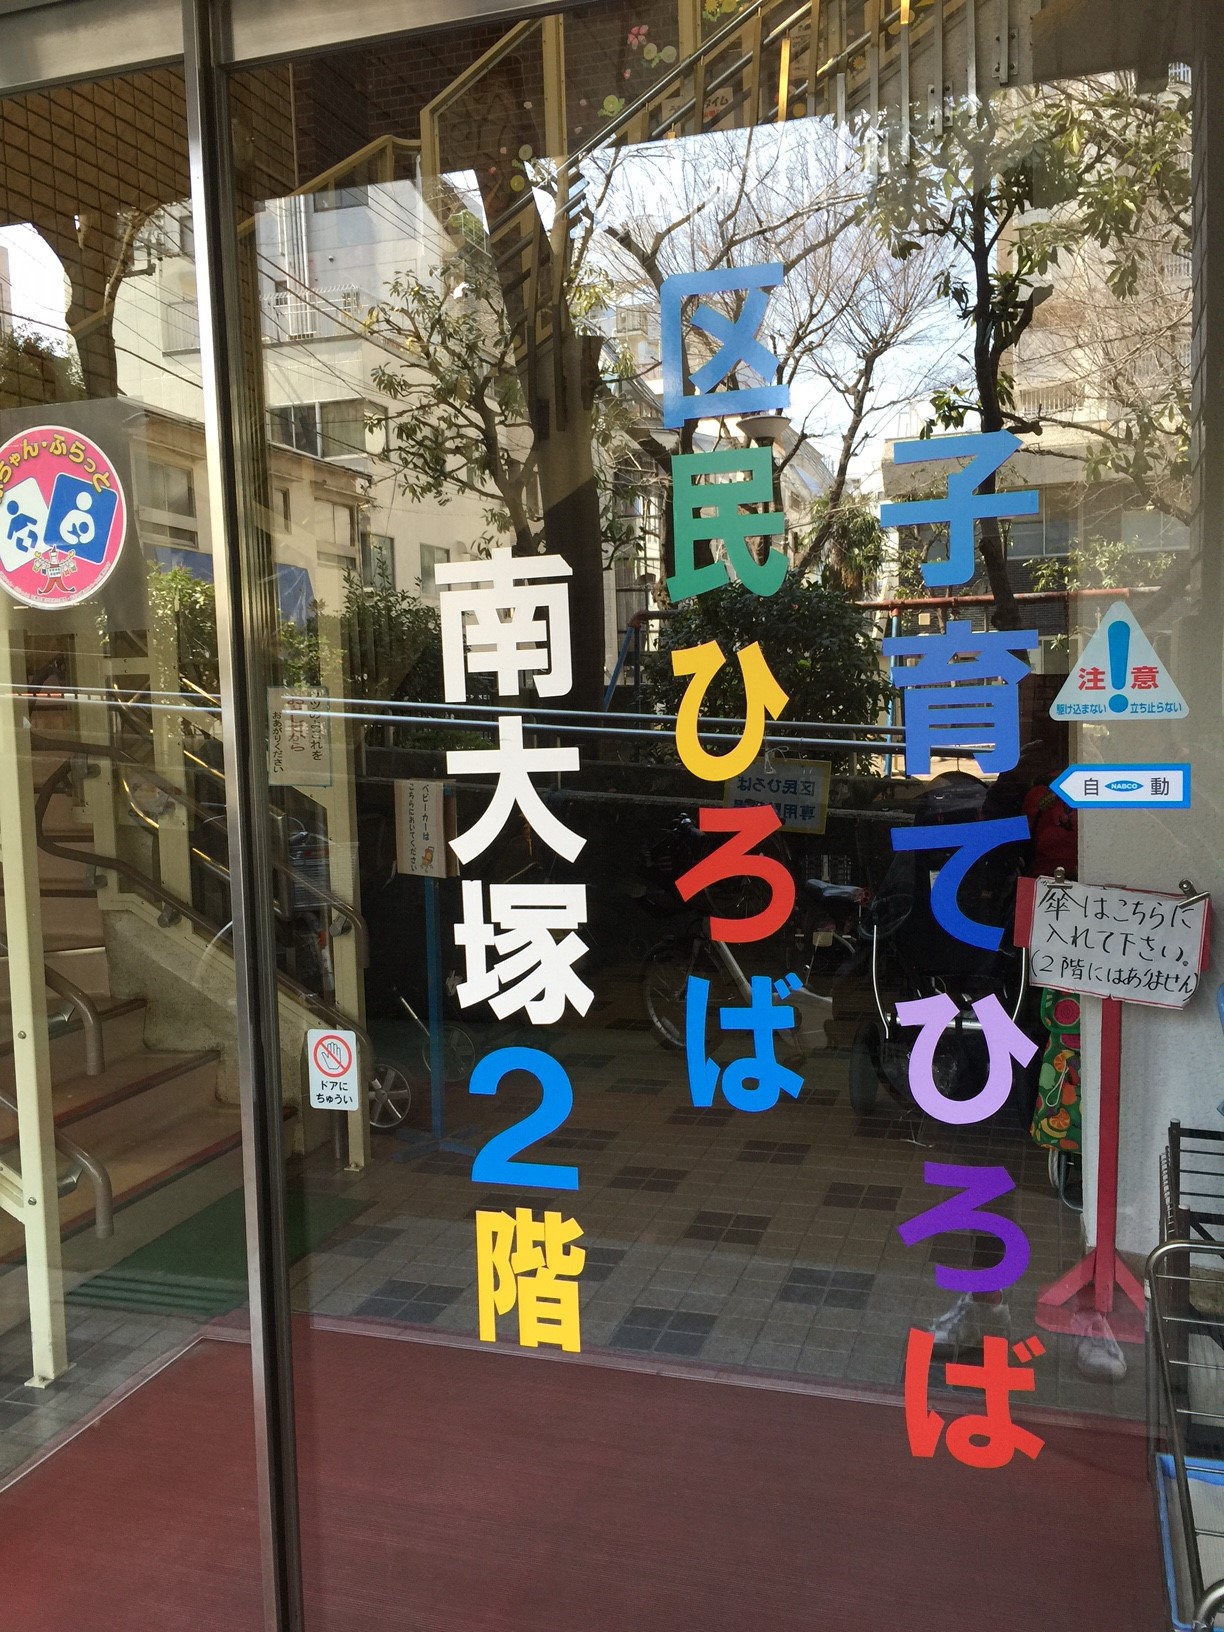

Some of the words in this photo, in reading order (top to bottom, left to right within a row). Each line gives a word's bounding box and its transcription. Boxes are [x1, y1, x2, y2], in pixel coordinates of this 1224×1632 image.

[660, 263, 804, 1112] 区民ひろば
[1056, 703, 1107, 715] 駆け込まない
[1130, 702, 1182, 714] 立ち止らない
[272, 711, 284, 773] おあがりください
[408, 783, 417, 872] こちらにおいてください
[422, 784, 430, 841] ベビーカーは
[1038, 887, 1195, 930] 傘はこちらに
[435, 548, 594, 1353] 南大塚2階
[881, 431, 1043, 1468] 子育てひろば
[316, 1093, 353, 1105] ちゅうい
[321, 1080, 349, 1091] ドアに
